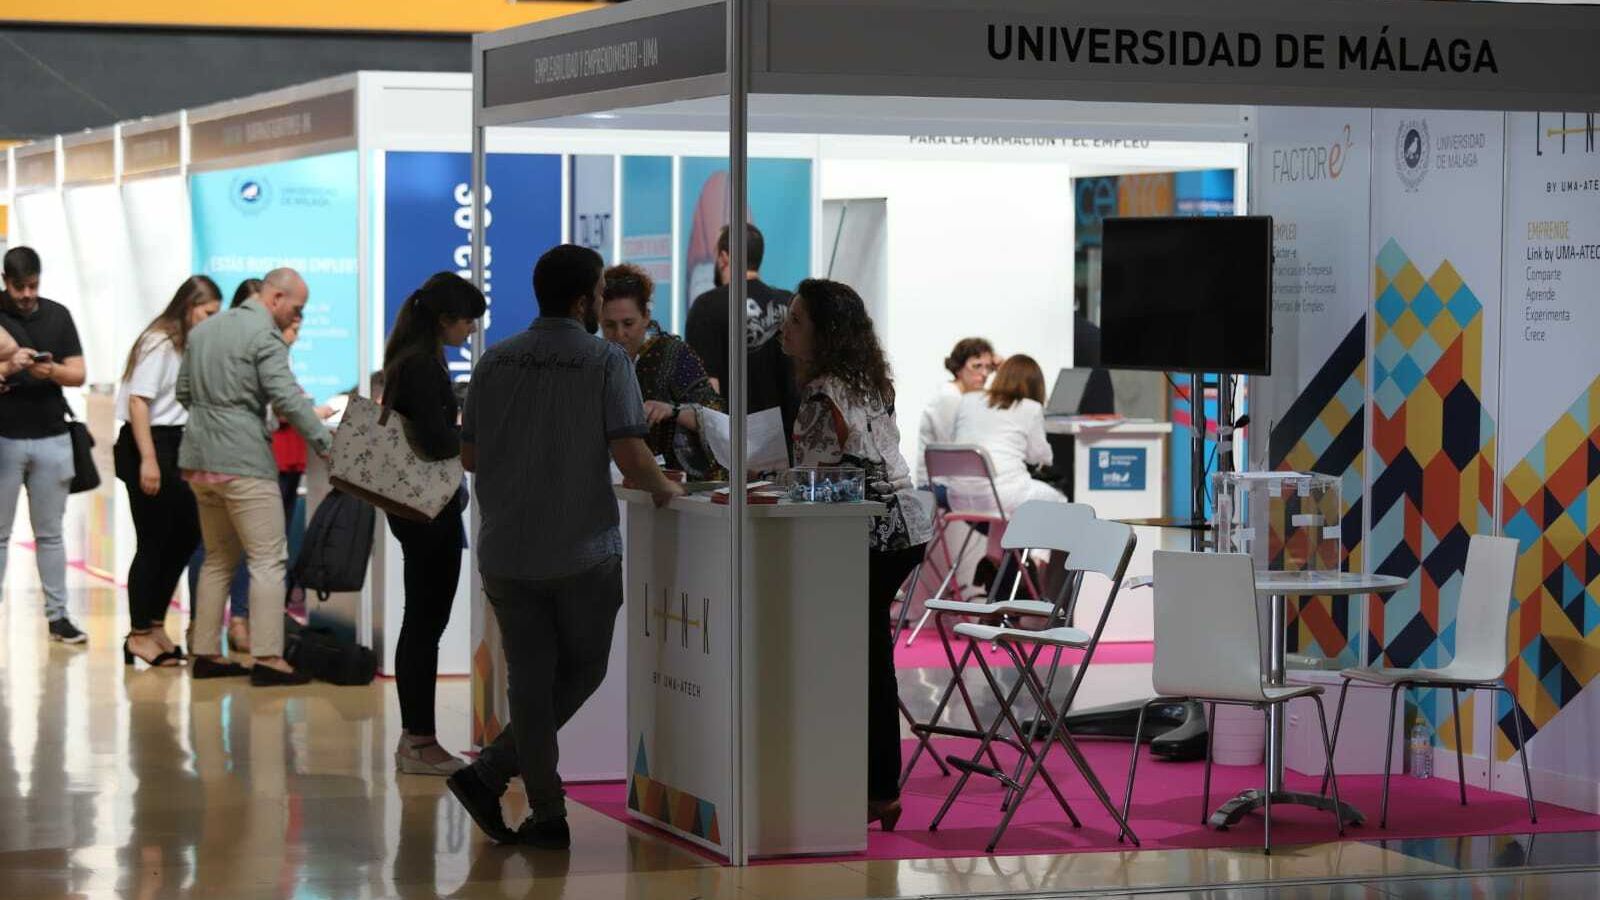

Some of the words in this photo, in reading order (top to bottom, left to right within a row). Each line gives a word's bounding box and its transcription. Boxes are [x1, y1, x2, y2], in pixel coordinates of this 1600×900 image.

[987, 23, 1261, 68] UNIVERSIDAD
[1275, 33, 1325, 70] DE
[1338, 24, 1499, 74] MÁLAGA
[1435, 132, 1486, 151] UNIVERSIDAD
[1436, 154, 1447, 170] DE
[1546, 181, 1557, 193] BY
[1527, 220, 1569, 241] EMPRENDE
[1526, 246, 1542, 261] Link
[1544, 245, 1554, 262] by
[1526, 265, 1562, 284] Comparte
[1525, 286, 1556, 303] Aprende
[1525, 305, 1571, 323] Experimenta
[1524, 325, 1546, 341] Crece
[644, 582, 710, 655] LINK
